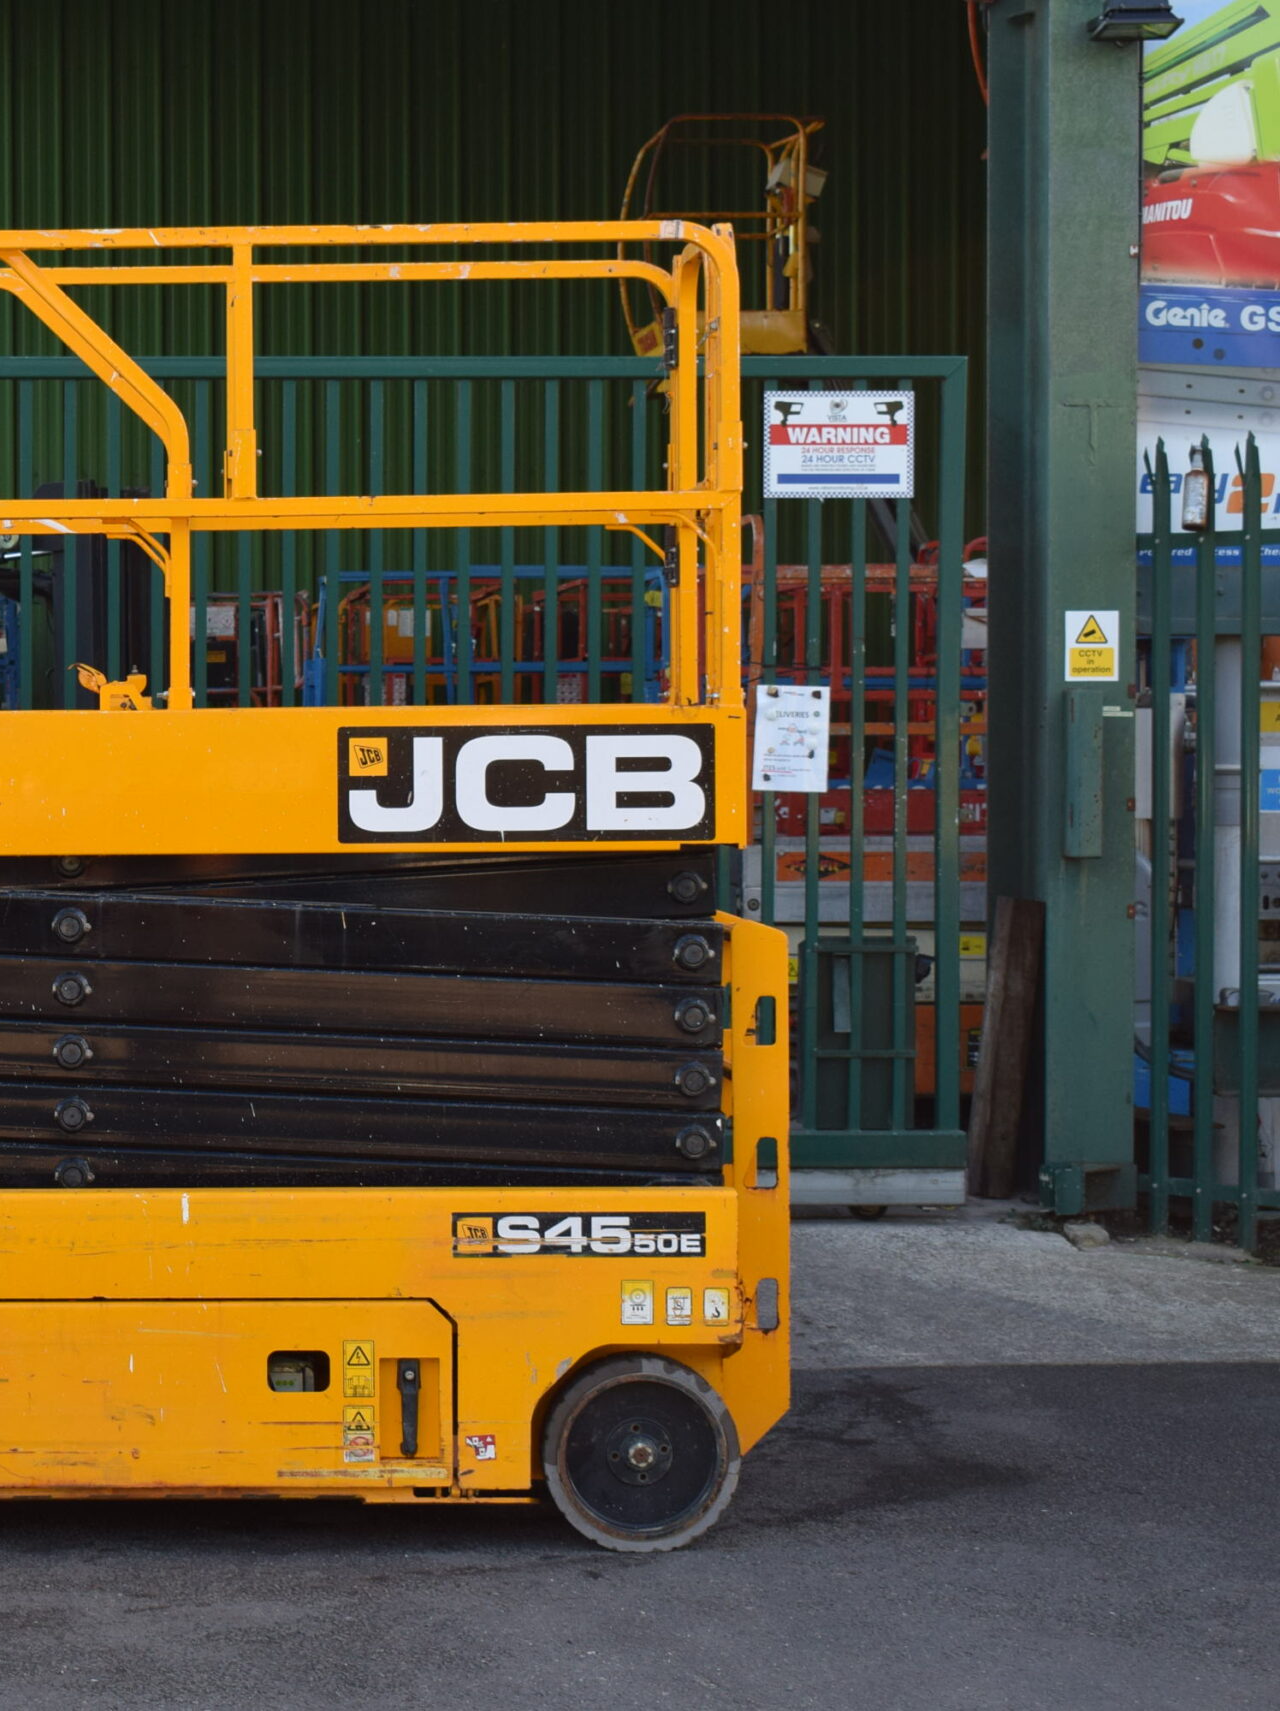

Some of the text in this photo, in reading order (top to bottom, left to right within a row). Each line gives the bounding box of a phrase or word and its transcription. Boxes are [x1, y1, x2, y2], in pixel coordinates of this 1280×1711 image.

[1145, 300, 1227, 328] Genie
[787, 426, 891, 444] WARNING
[801, 455, 876, 464] 24 HOUR CCTV
[1078, 649, 1103, 658] CCTV
[1072, 665, 1111, 674] operation
[358, 747, 382, 766] JCB
[349, 735, 706, 832] JCB
